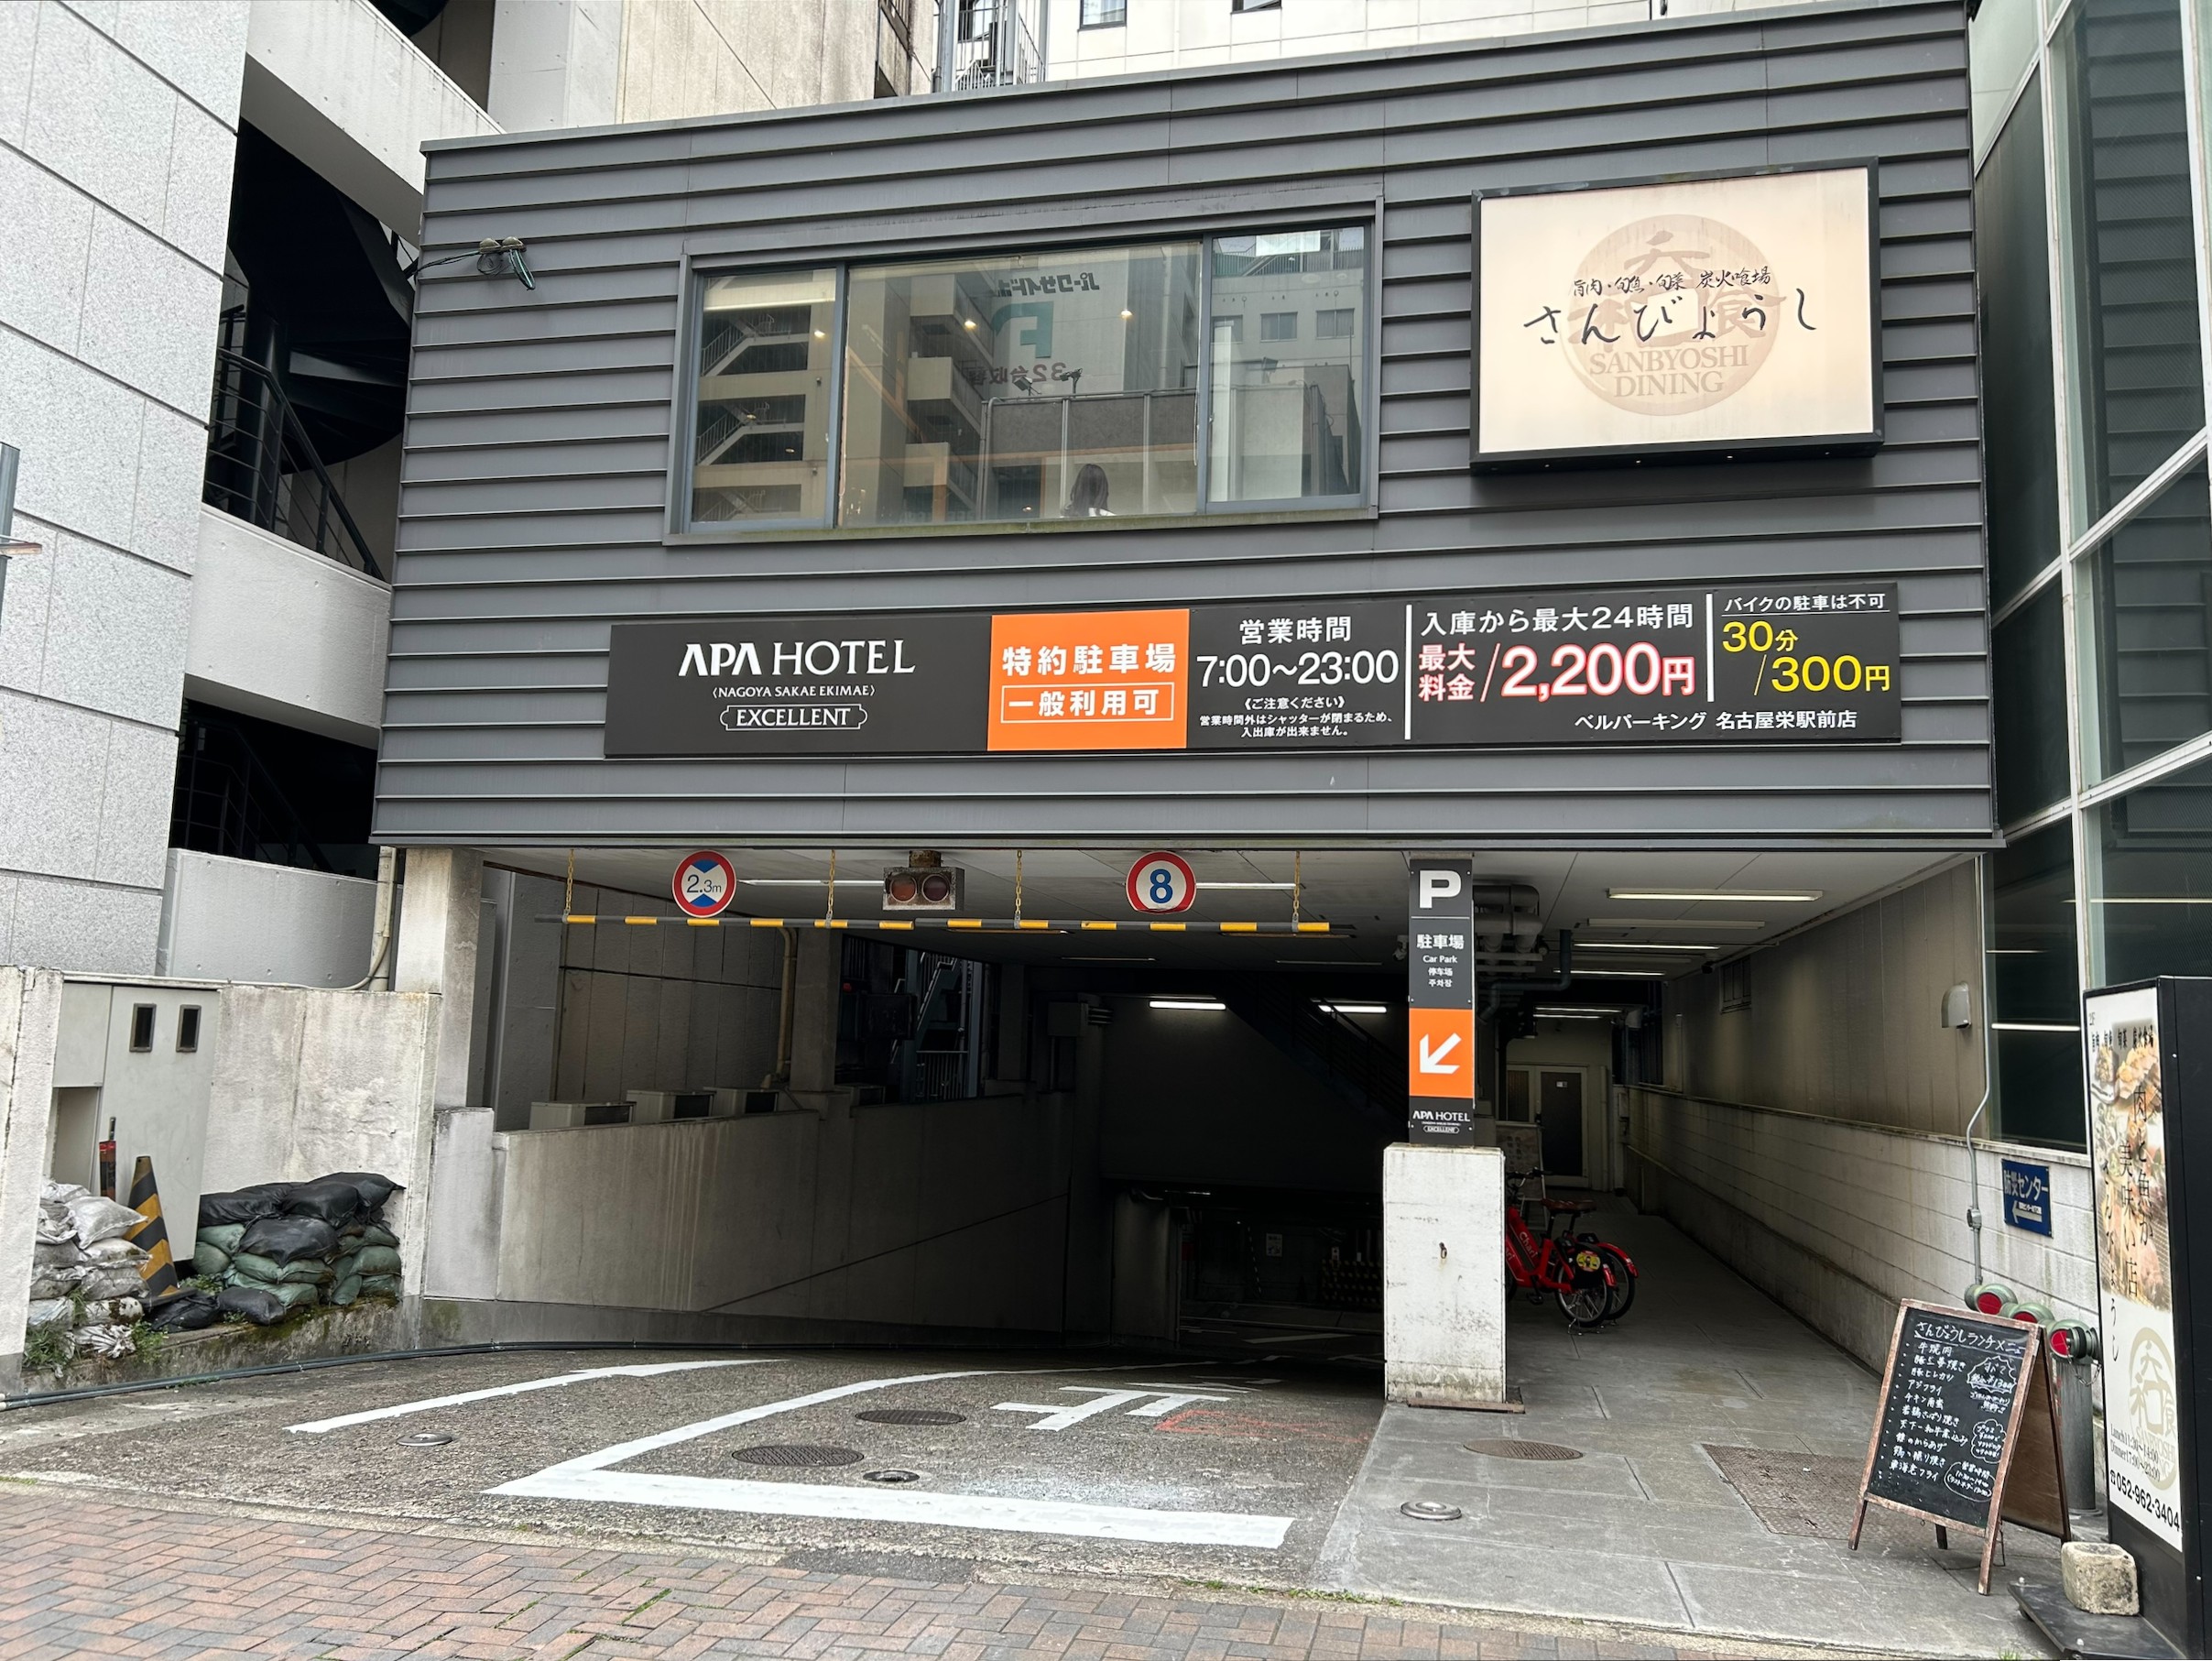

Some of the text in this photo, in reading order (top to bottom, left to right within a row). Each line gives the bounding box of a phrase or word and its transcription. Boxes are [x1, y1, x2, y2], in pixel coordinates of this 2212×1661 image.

[1523, 288, 1817, 344] さんびょうし
[1589, 344, 1749, 376] SANBYOSHI
[1614, 371, 1724, 398] DINING
[1725, 594, 1886, 612] バイクの駐車は不可
[1239, 616, 1351, 645] 営業時間
[1421, 603, 1694, 637] 入庫から最大24時間
[1722, 620, 1799, 652] 30分
[678, 639, 916, 676] APA HOTEL
[1002, 643, 1176, 676] 特約駐車場
[1419, 642, 1476, 672] 最大
[775, 685, 816, 698] SAKAE
[1419, 672, 1476, 702] 料金
[1008, 689, 1159, 716] 一般利用可
[736, 707, 851, 727] EXCELLENT
[1199, 711, 1393, 727] 営業時間外はシャッターが閉まるため、
[1575, 710, 1858, 731] ベルパーキング 名古屋栄駅前店
[1241, 725, 1348, 738] 入出庫が出来ません。
[687, 874, 722, 893] 2.3m
[1150, 869, 1173, 903] 8
[1419, 869, 1462, 908] P
[1416, 934, 1465, 949] 駐車場
[1422, 955, 1458, 964] Car Park
[1428, 978, 1453, 988] 주차장
[1412, 1109, 1471, 1122] APA HOTEL
[1908, 1379, 1942, 1396] アジフライ
[2116, 1473, 2180, 1532] 052-962-3404
